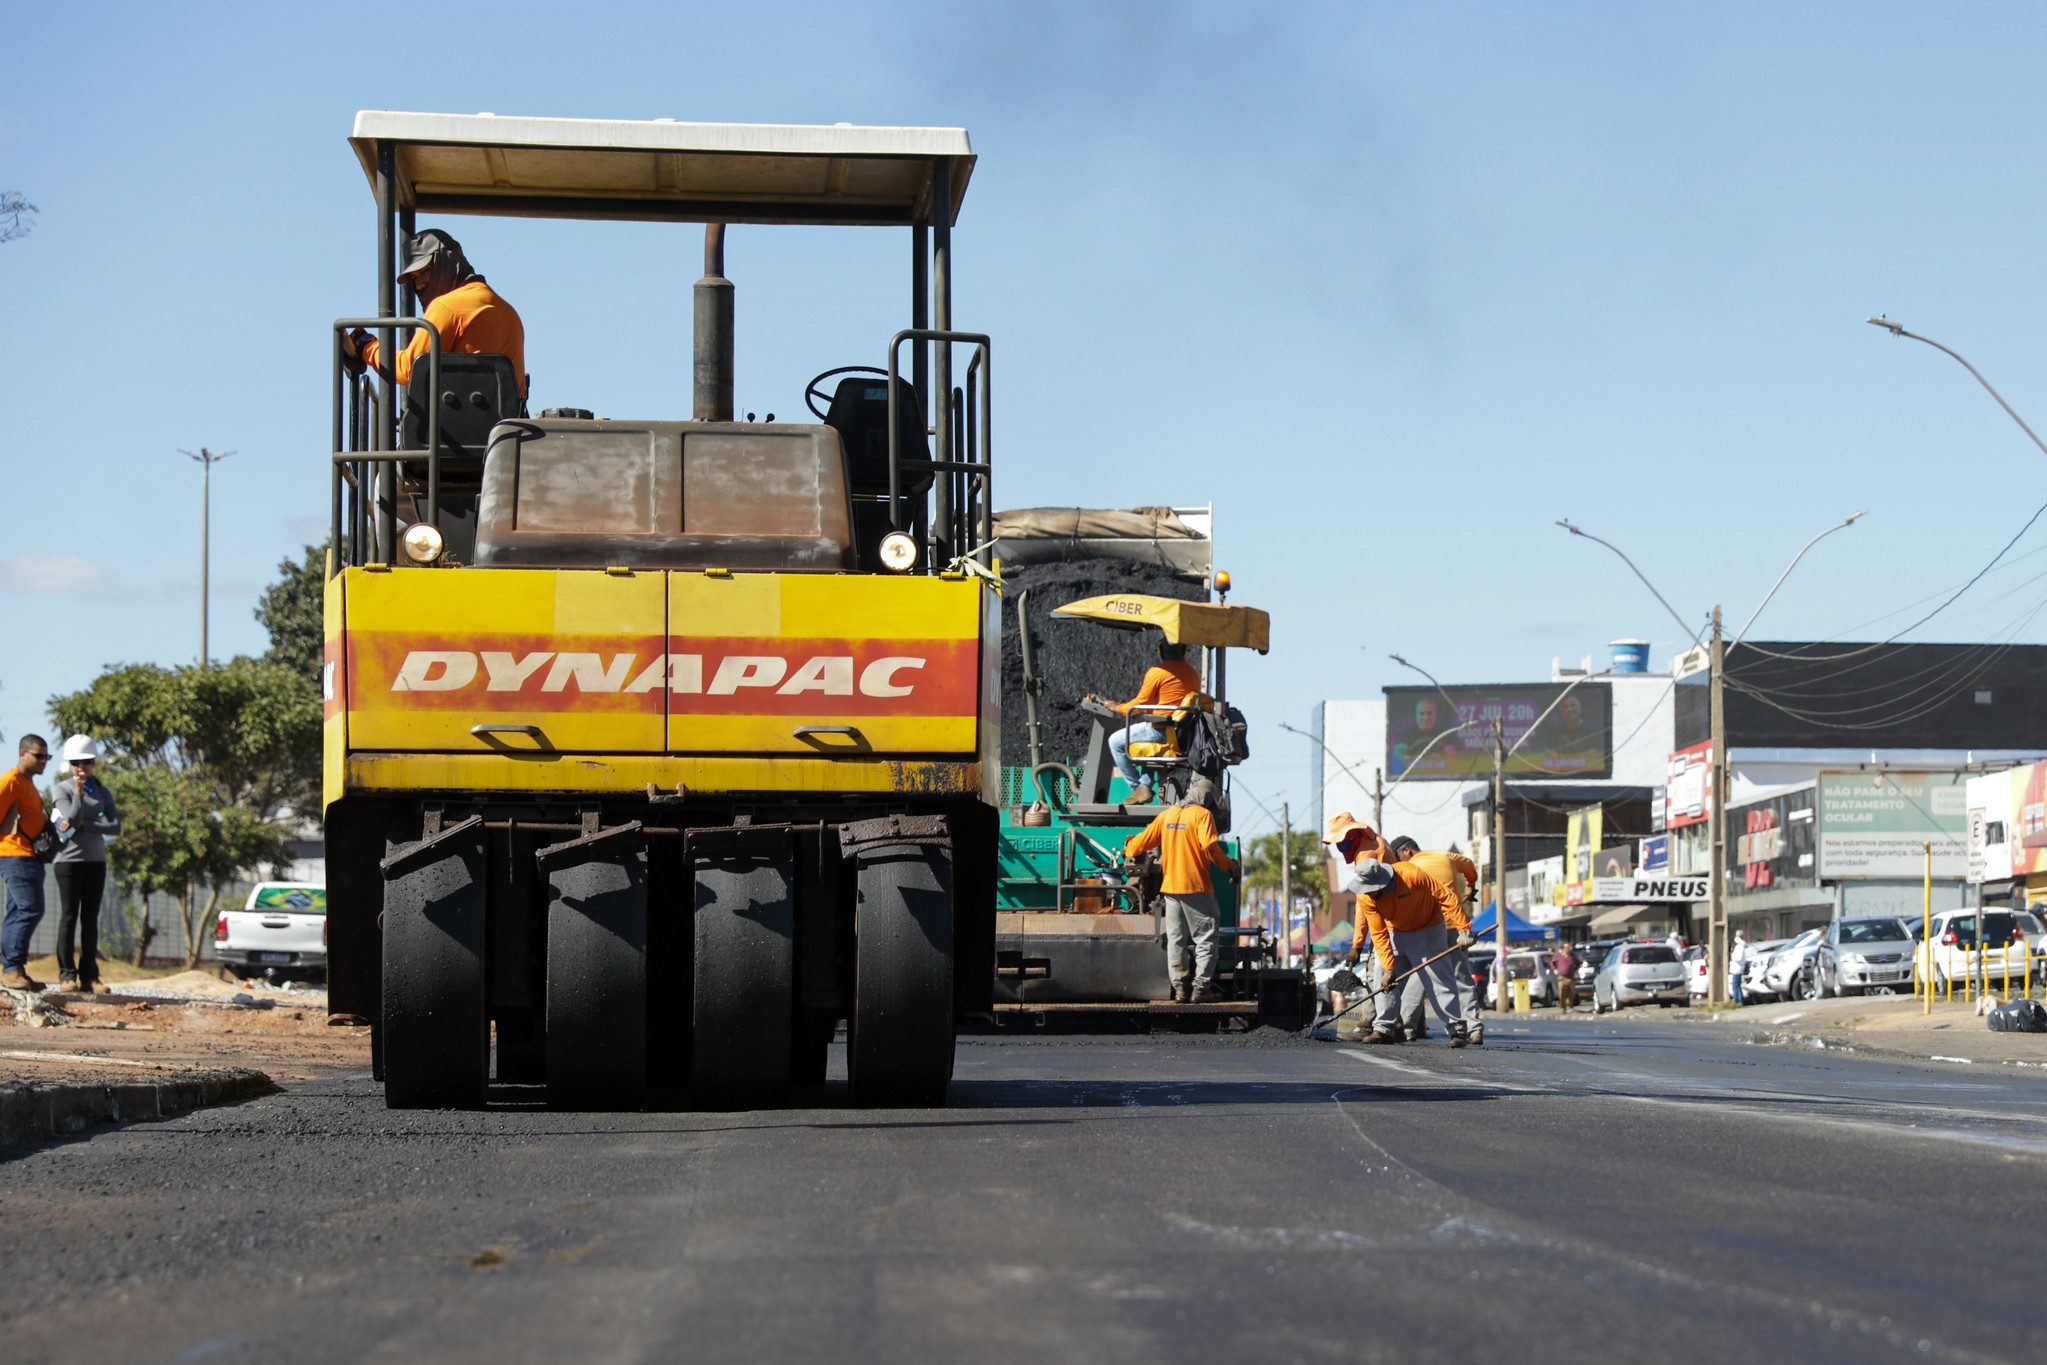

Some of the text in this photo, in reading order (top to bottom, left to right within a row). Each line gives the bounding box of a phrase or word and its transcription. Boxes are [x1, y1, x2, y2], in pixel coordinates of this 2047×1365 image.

[1105, 600, 1143, 616] CIBER
[391, 650, 926, 698] DYNAPAC
[1508, 704, 1535, 721] 20h
[1824, 785, 1923, 797] NÃO PARE O SEU
[1825, 800, 1905, 810] TRATAMENTO
[1825, 813, 1874, 823] OCULAR
[1973, 821, 1980, 838] E
[1825, 839, 1841, 847] Nós
[1878, 839, 1924, 848] preparados
[1844, 849, 1863, 857] toda
[1825, 858, 1869, 868] prioridade!
[1634, 881, 1708, 897] PNEUS
